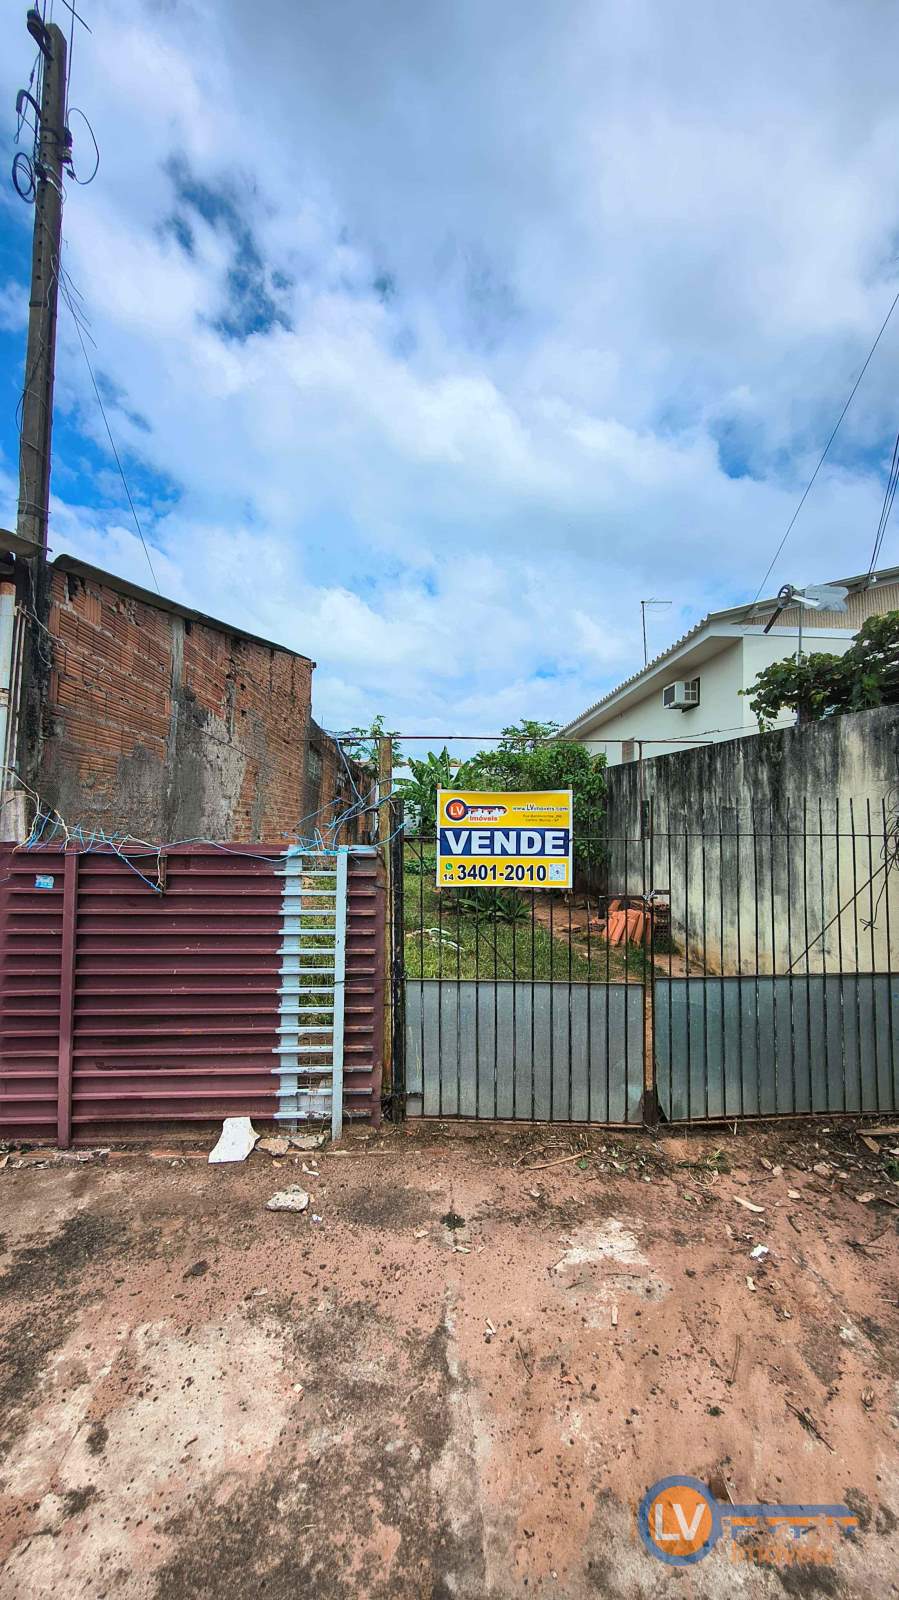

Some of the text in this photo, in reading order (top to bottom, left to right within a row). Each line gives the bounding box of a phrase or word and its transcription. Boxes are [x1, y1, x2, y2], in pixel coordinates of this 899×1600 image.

[450, 806, 463, 816] LV
[445, 831, 565, 855] VENDE
[457, 864, 547, 881] 3401-2010
